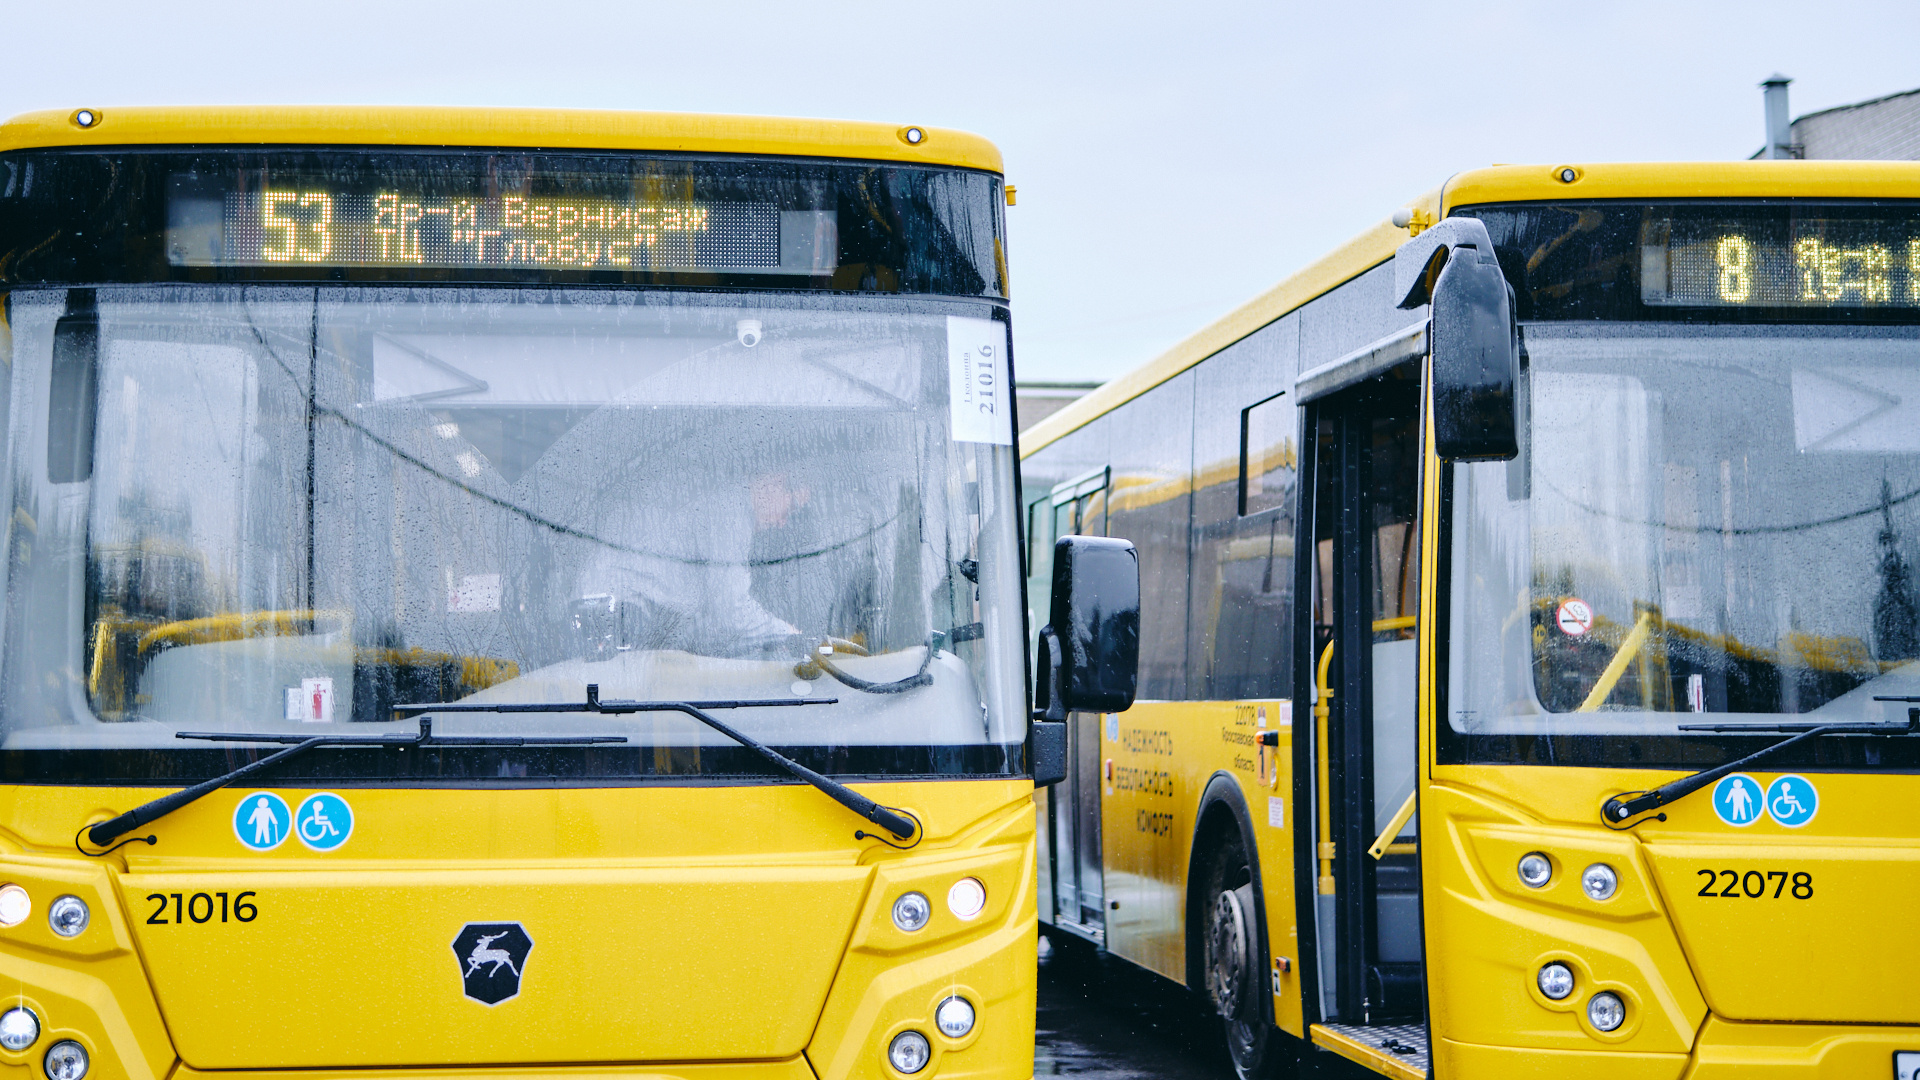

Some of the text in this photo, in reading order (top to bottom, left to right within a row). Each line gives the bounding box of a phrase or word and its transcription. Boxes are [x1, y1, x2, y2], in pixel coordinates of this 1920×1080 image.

[264, 191, 333, 263] 53
[374, 193, 709, 234] Яр-й Вернисаж
[374, 228, 657, 268] ТЦ "Глобус"
[1717, 236, 1750, 302] 8
[1803, 270, 1889, 300] 15-й
[977, 344, 994, 416] 21016
[1235, 705, 1256, 726] 22078
[1122, 729, 1174, 757] НАДЕЖНОСТЬ
[1234, 753, 1256, 773] область
[1116, 766, 1174, 798] БЕЗОПАСНОСТЬ
[1136, 808, 1174, 839] КОМФОРТ
[1696, 868, 1814, 900] 22078
[146, 891, 258, 925] 21016
